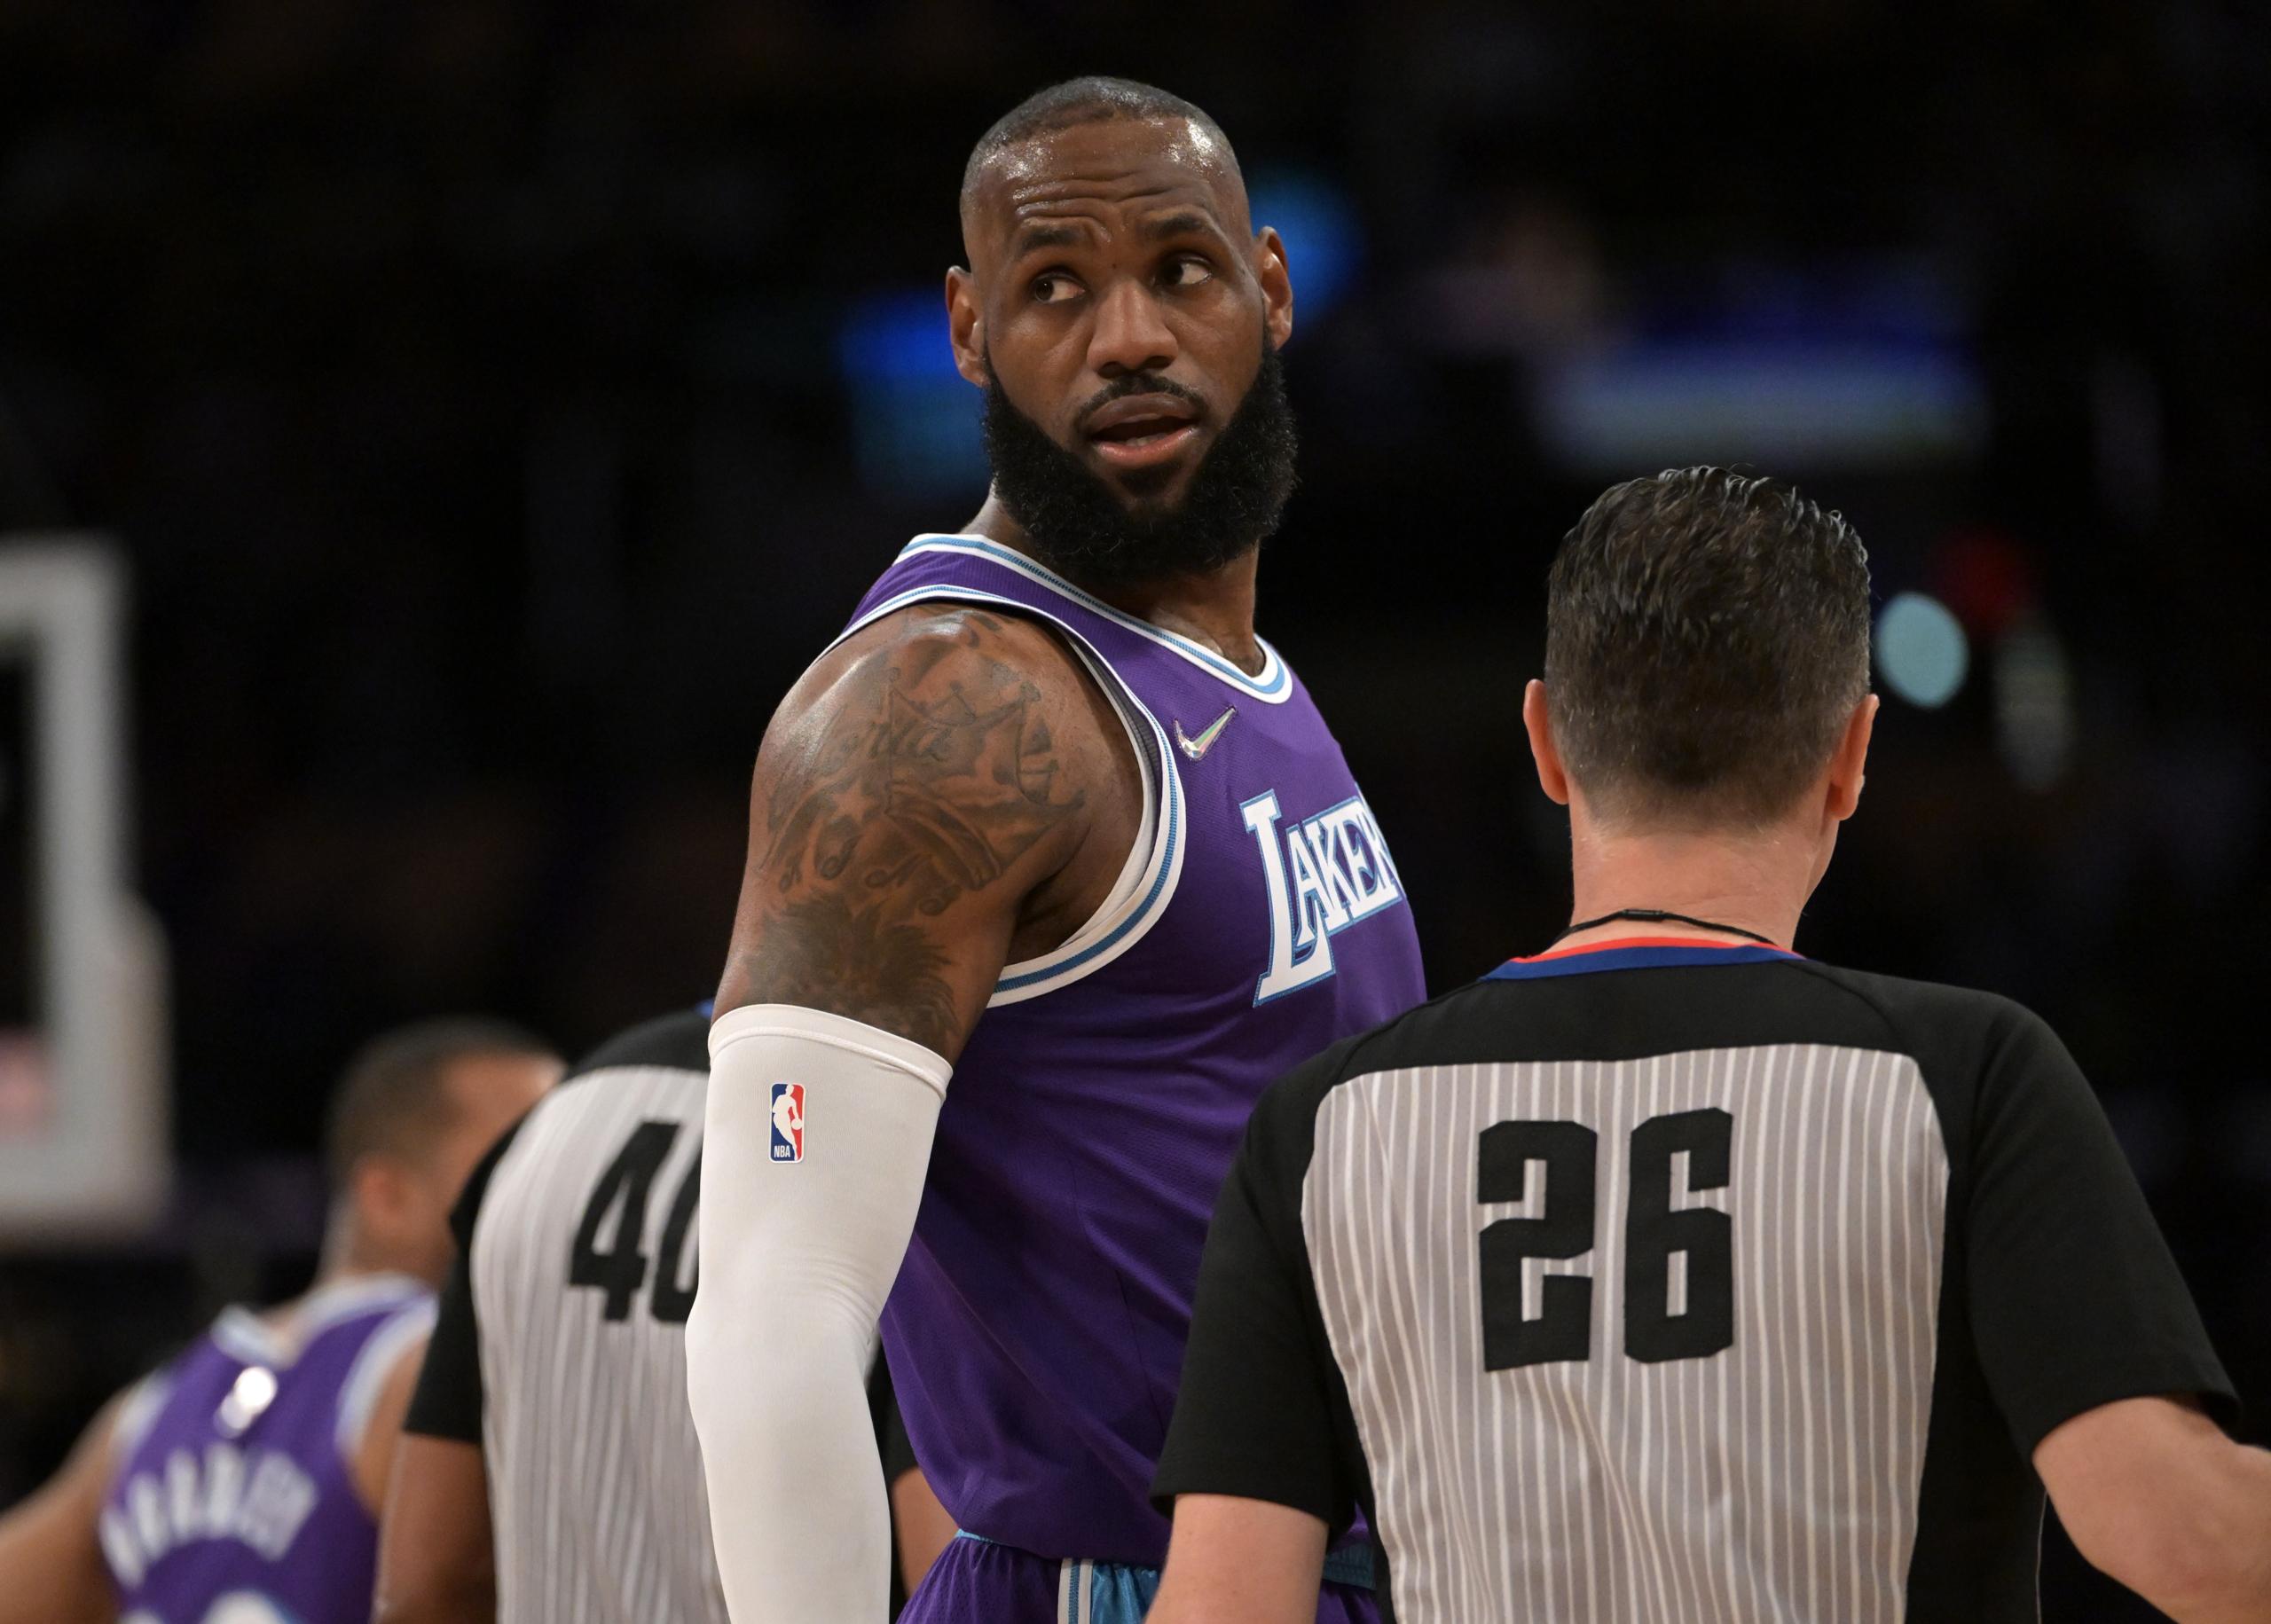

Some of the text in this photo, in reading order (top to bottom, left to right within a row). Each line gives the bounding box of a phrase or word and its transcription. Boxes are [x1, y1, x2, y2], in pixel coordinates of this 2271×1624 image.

[1239, 786, 1408, 1008] LAKER
[774, 1145, 790, 1157] NBA
[1477, 1107, 1733, 1372] 26
